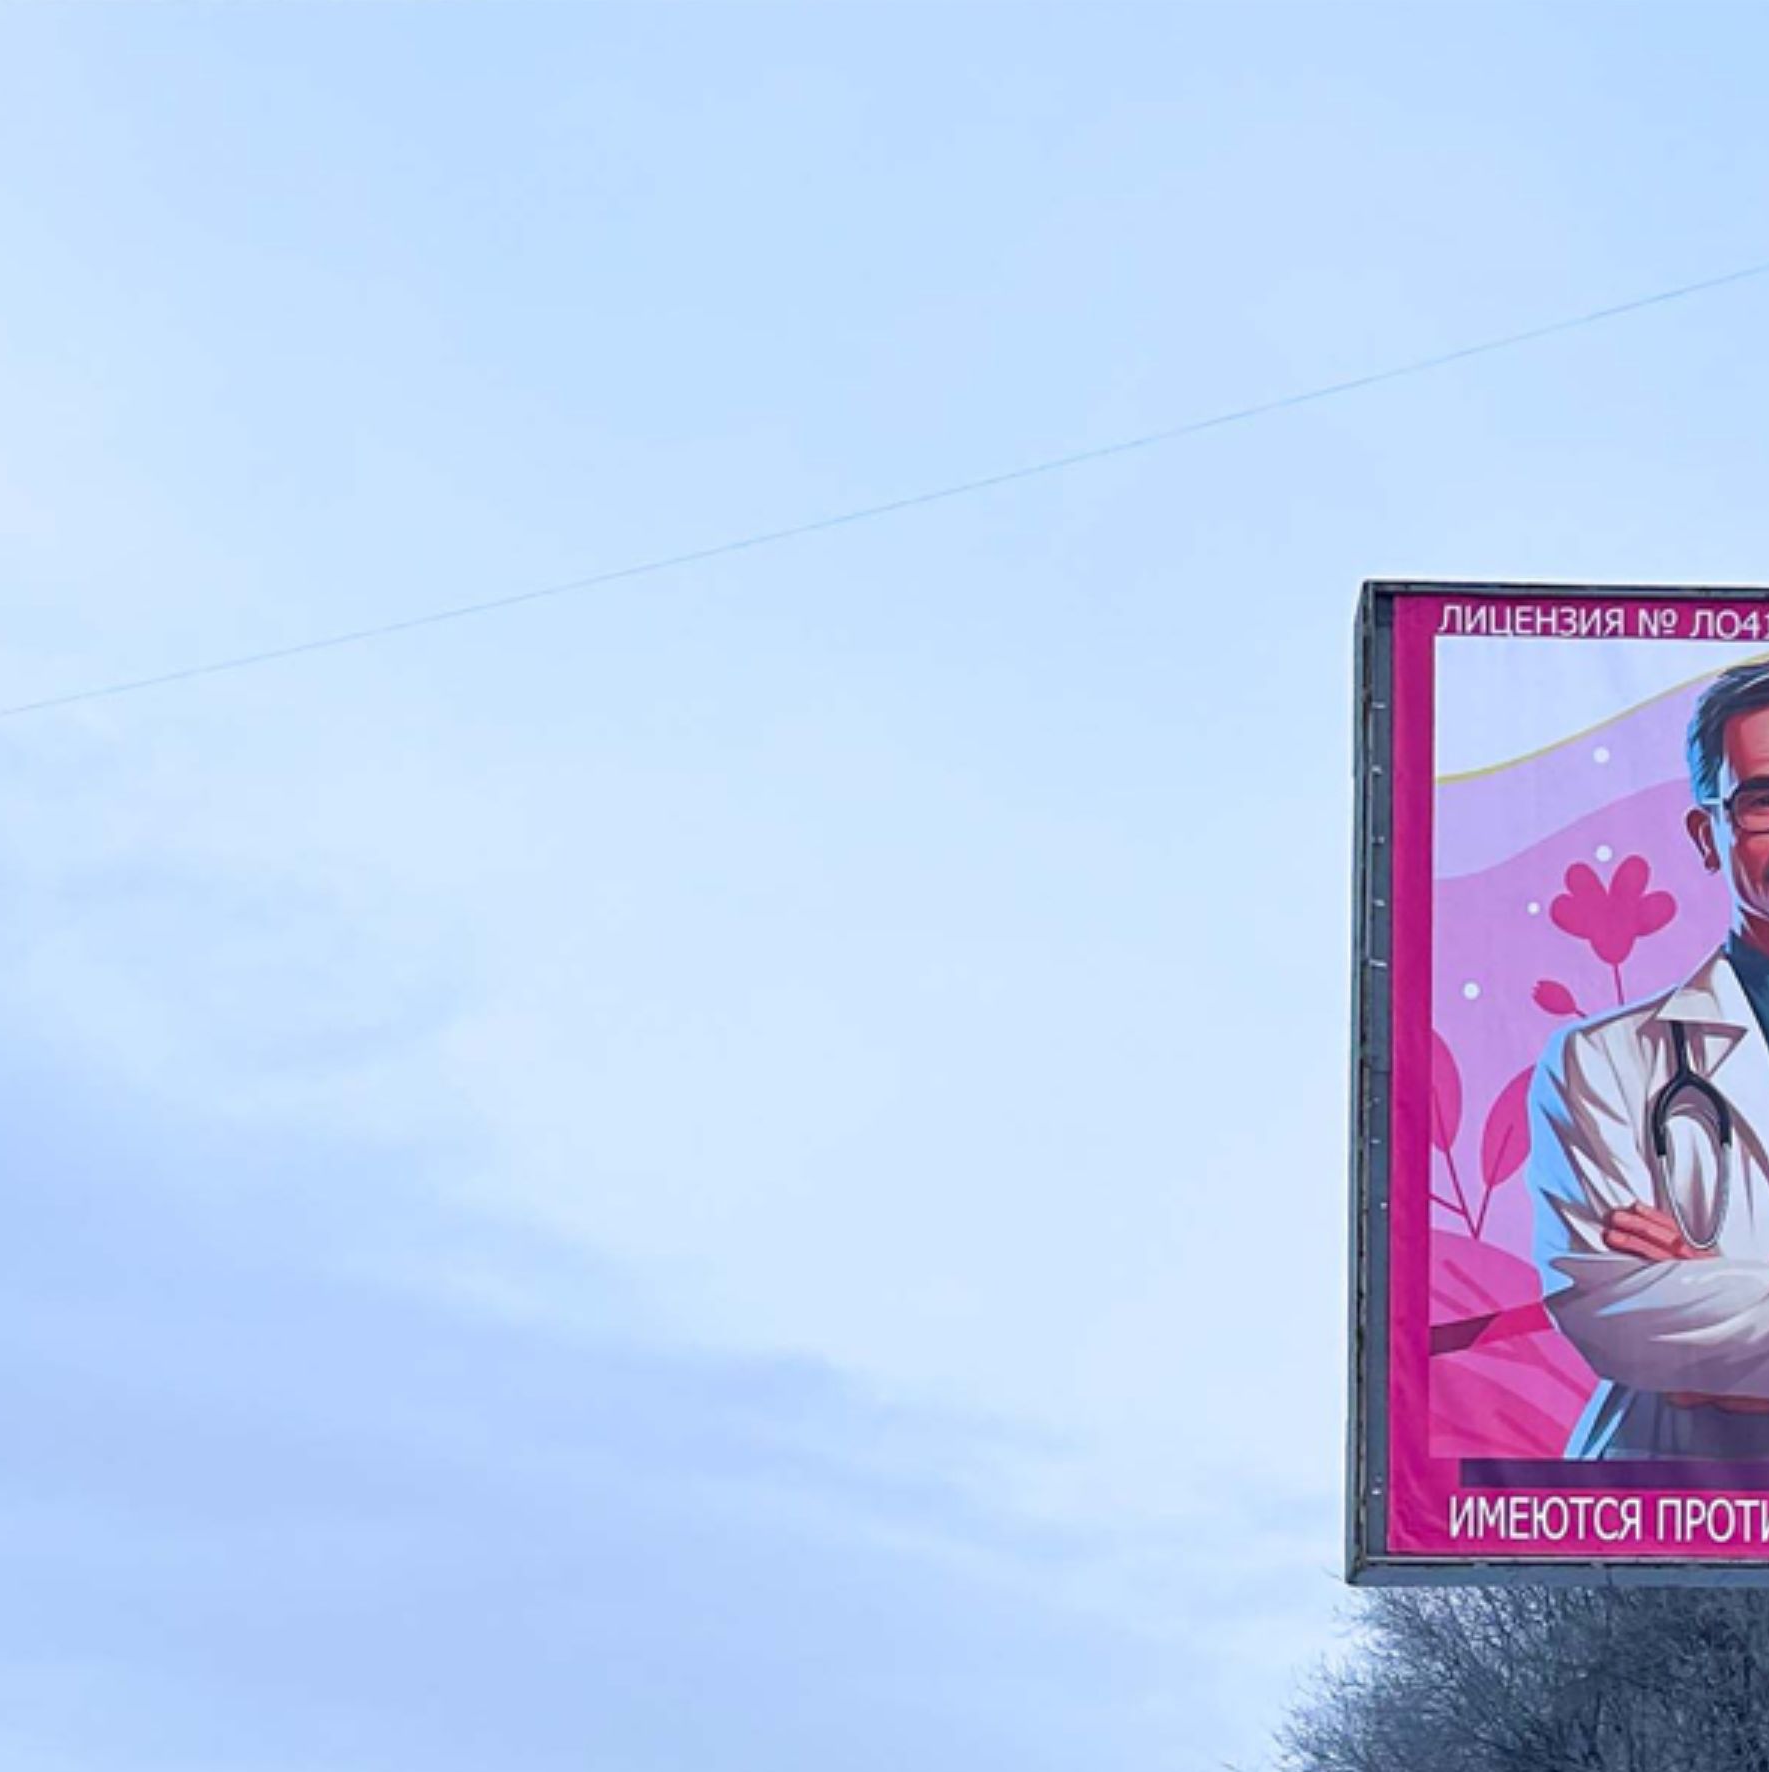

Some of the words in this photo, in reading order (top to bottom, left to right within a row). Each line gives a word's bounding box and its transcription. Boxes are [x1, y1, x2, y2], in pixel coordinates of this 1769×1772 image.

[1439, 603, 1625, 638] ЛИЦЕНЗИЯ
[1637, 607, 1679, 636] №
[1448, 1495, 1643, 1543] ИМЕЮТСЯ
